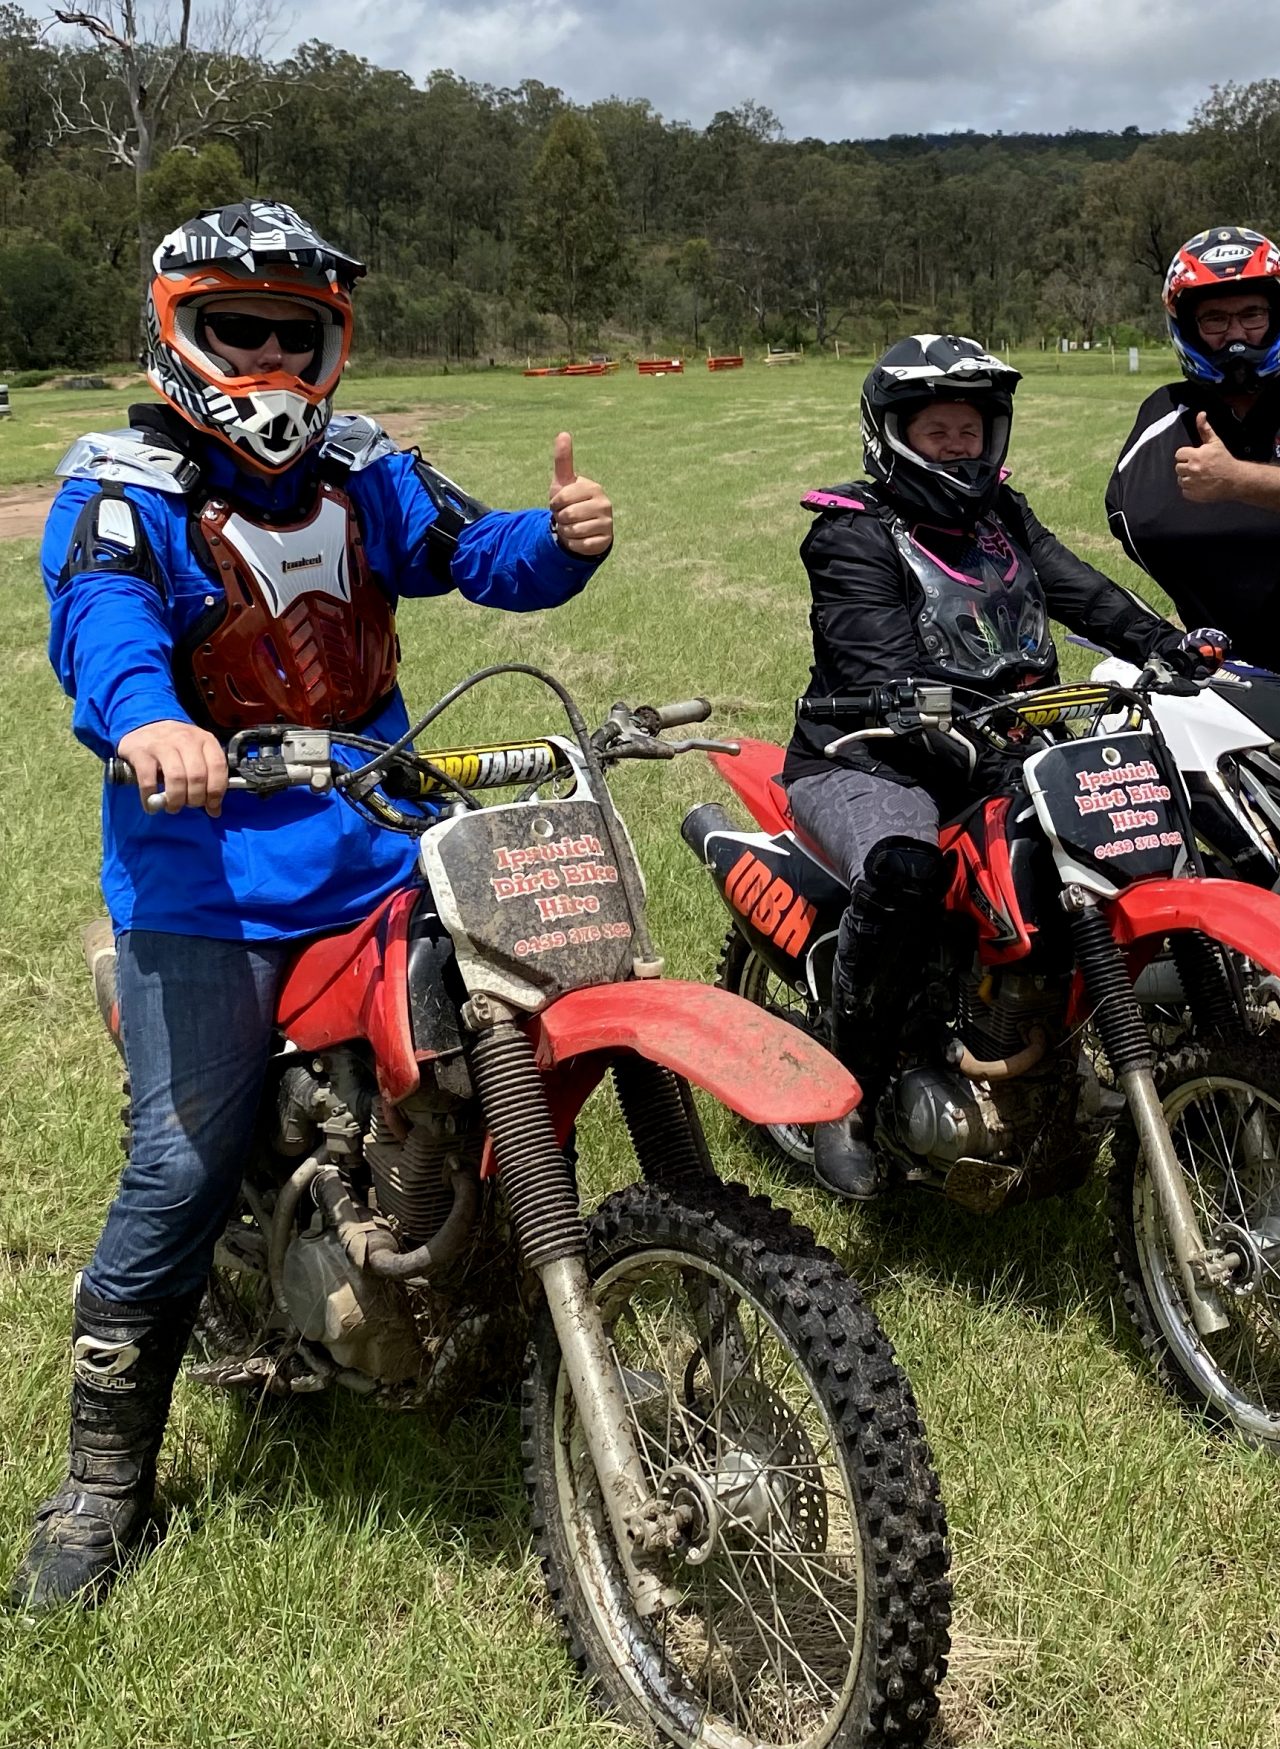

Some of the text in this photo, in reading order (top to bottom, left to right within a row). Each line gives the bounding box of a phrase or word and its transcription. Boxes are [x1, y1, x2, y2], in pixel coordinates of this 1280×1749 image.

[1204, 248, 1245, 260] Arai
[1076, 761, 1159, 792] Ipswich
[1074, 782, 1171, 816] Dirt Bike
[1108, 809, 1158, 833] Hire
[493, 834, 604, 872] Ipswich
[491, 861, 618, 902] Dirt Bike
[535, 894, 600, 923] Hire
[725, 850, 818, 959] IDBH
[514, 931, 566, 957] 0439
